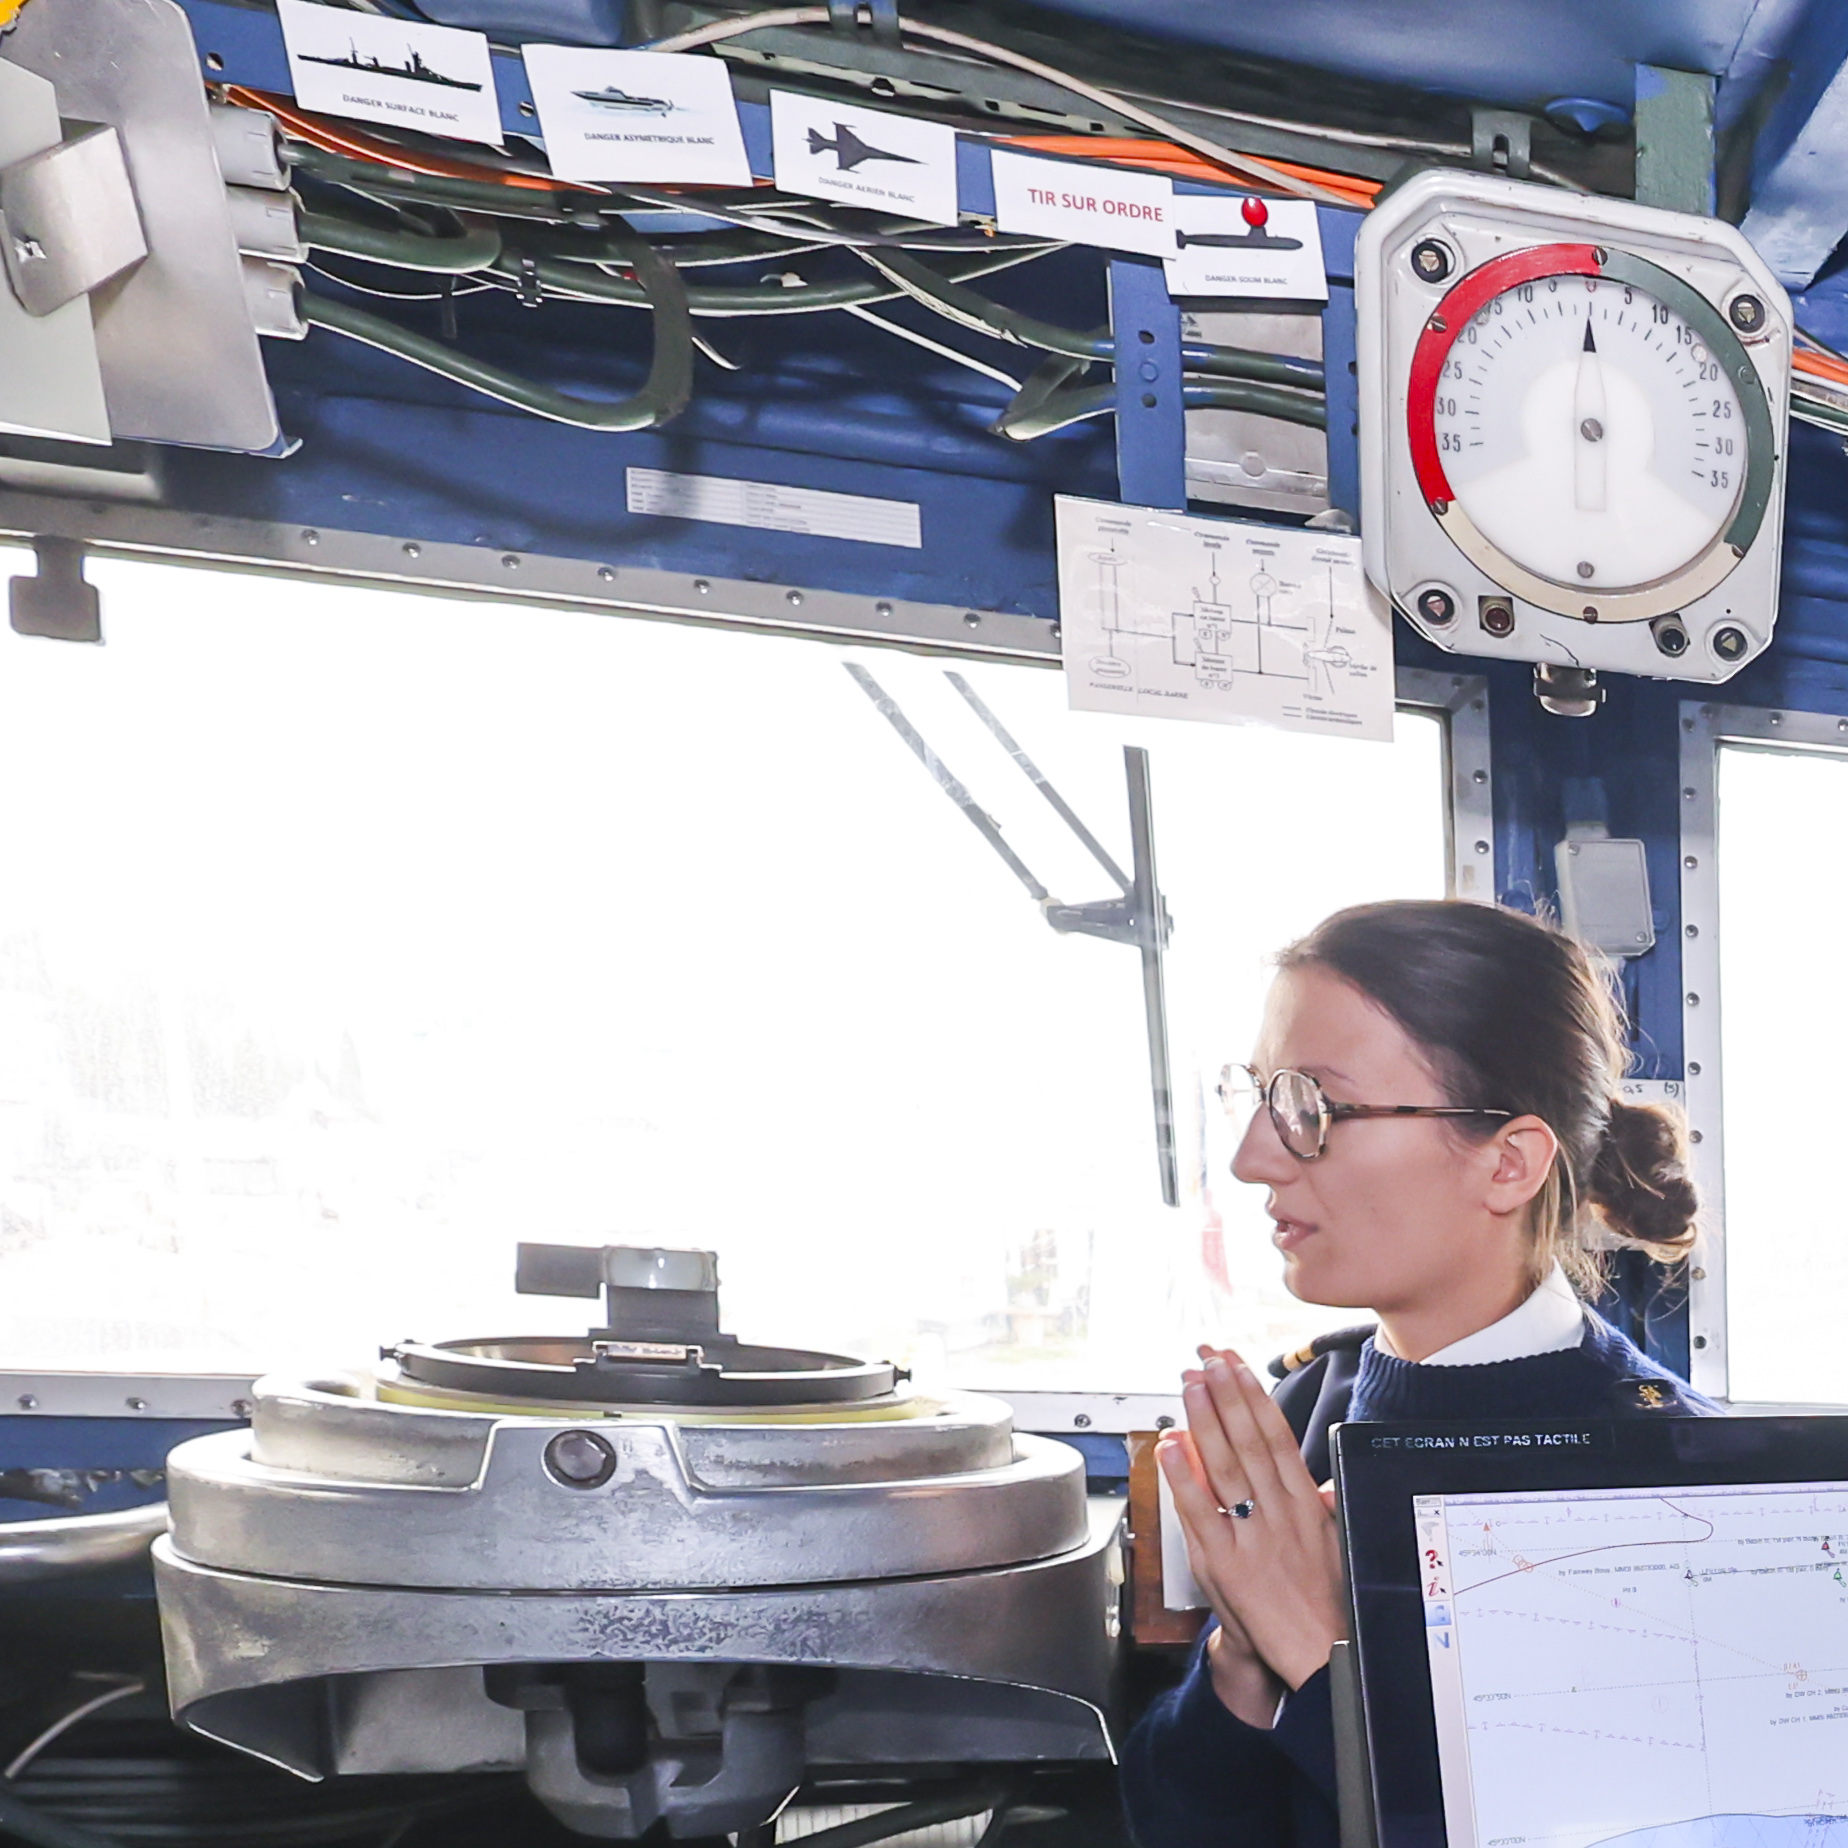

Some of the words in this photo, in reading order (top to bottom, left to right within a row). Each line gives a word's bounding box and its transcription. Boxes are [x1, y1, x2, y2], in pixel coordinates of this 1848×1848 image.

[342, 94, 384, 108] DANGER
[385, 101, 425, 117] SURFACE
[429, 110, 459, 122] BLANC
[584, 132, 621, 141] DANGER
[623, 134, 685, 144] ASYMETRIQUE
[687, 136, 715, 145] BLANC
[818, 176, 854, 193] DANGER
[856, 184, 886, 198] AERIEN
[888, 190, 915, 202] BLANC
[1027, 188, 1057, 208] TIR
[1061, 192, 1098, 212] SUR
[1102, 198, 1164, 222] ORDRE
[1205, 274, 1236, 284] DANGER
[1261, 277, 1288, 286] BLANC
[1517, 286, 1533, 303] 10
[1624, 286, 1633, 305] 5
[1652, 306, 1669, 324] 10
[1459, 327, 1477, 345] 20
[1676, 326, 1693, 345] 15
[1443, 361, 1462, 379] 25
[1700, 364, 1718, 382] 20
[1436, 398, 1456, 416] 30
[1712, 401, 1732, 420] 25
[1442, 432, 1461, 452] 35
[1715, 437, 1734, 456] 30
[1711, 471, 1729, 489] 35
[1371, 1435, 1400, 1449] CET
[1405, 1435, 1455, 1449] ECRAN
[1458, 1434, 1470, 1448] N
[1473, 1434, 1500, 1448] EST
[1503, 1433, 1532, 1447] PAS
[1535, 1432, 1591, 1447] TACTILE
